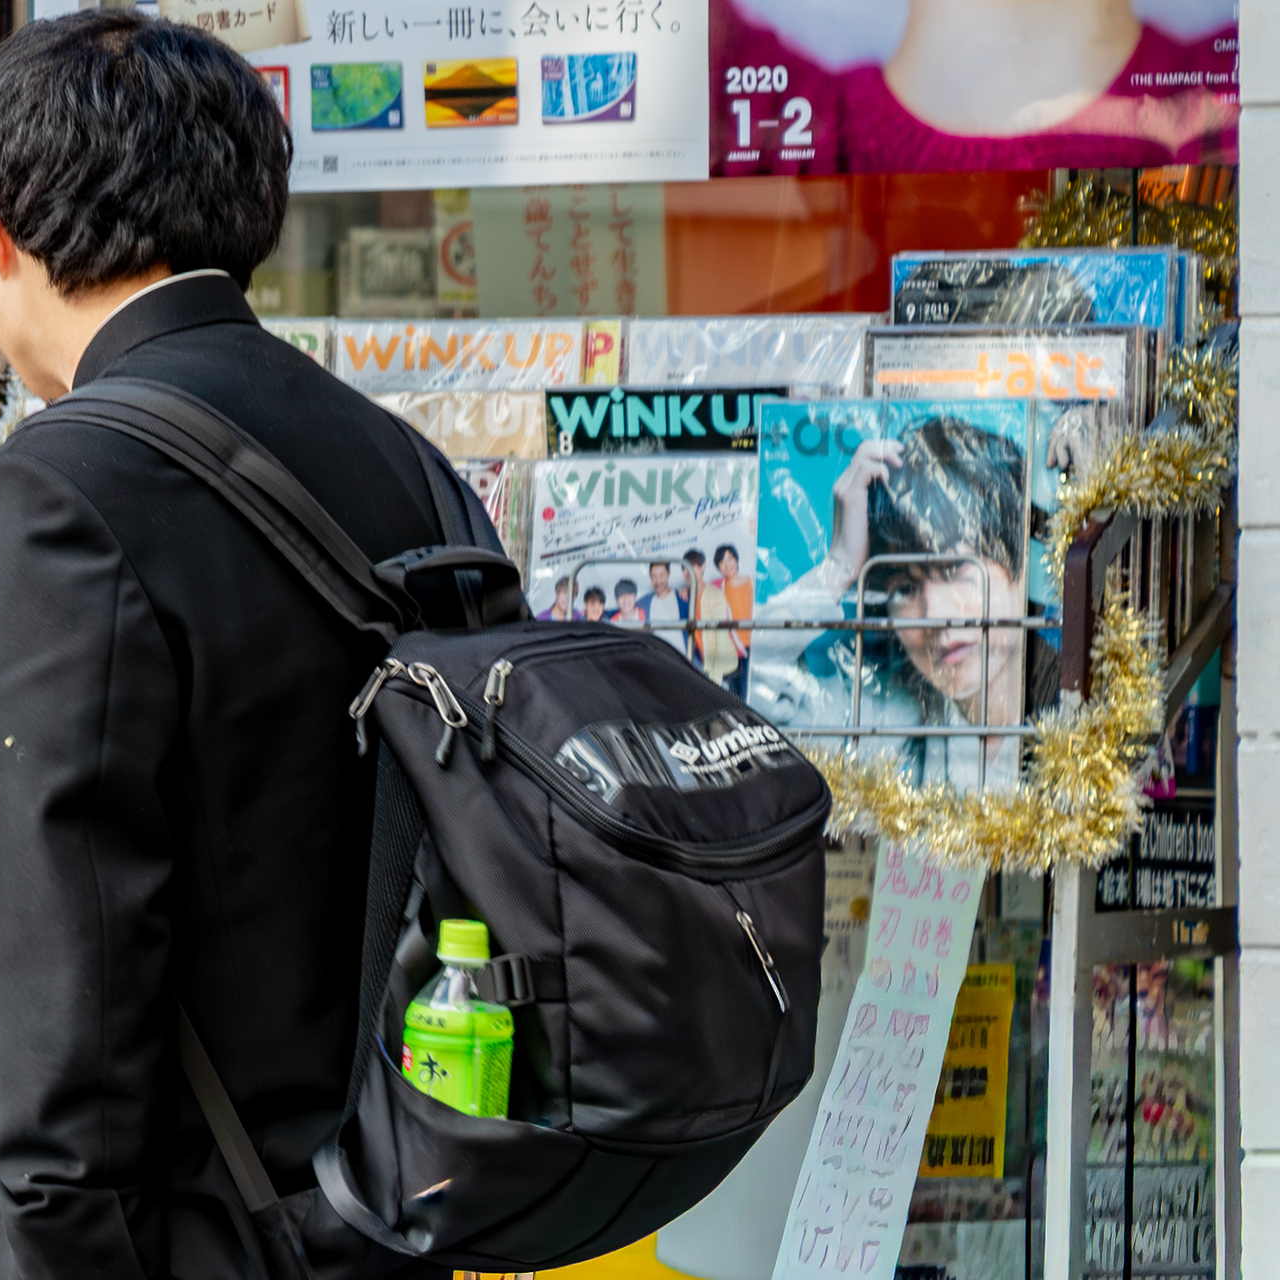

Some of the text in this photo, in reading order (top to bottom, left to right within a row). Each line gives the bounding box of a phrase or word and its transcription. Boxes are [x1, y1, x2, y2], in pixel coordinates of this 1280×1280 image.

[726, 66, 789, 95] 2020
[1155, 71, 1204, 87] RAMPAGE
[1205, 70, 1228, 85] from
[700, 723, 781, 764] umbro
